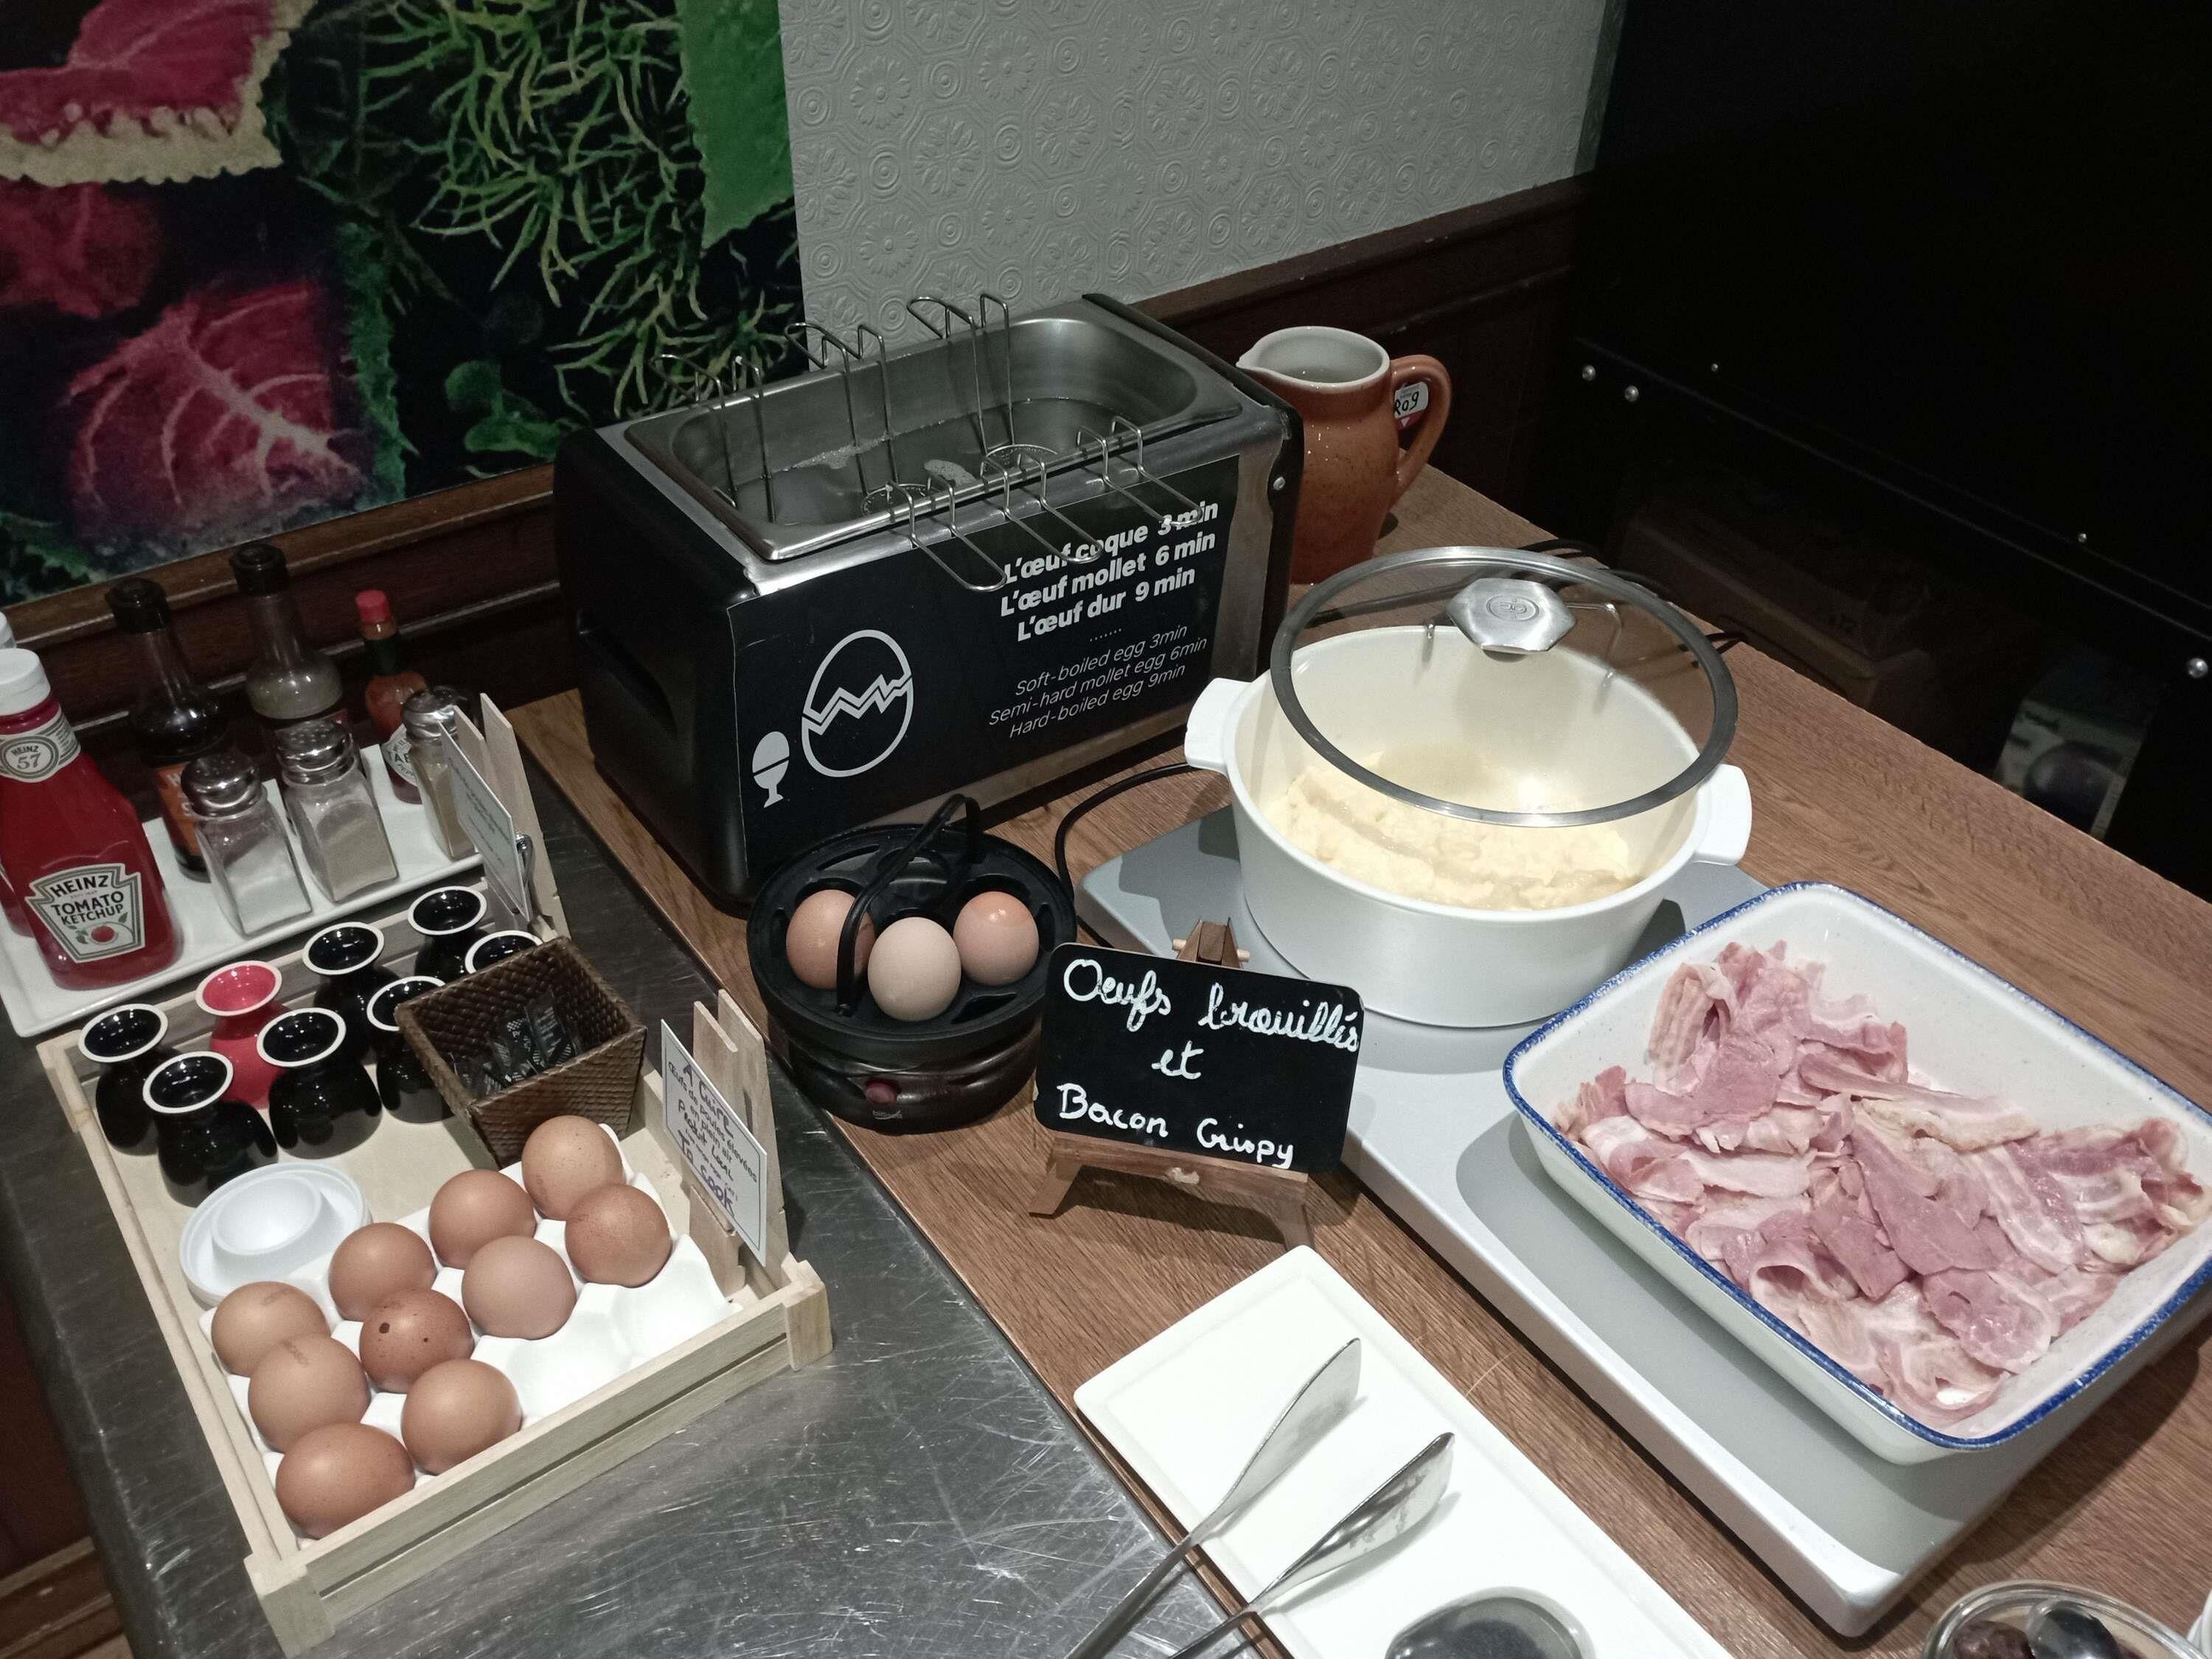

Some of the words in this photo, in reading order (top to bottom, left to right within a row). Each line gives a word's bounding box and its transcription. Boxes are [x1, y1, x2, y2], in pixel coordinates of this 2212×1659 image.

[1004, 543, 1071, 583] L'œuf
[1158, 515, 1172, 535] 3
[1176, 501, 1218, 530] min
[1001, 574, 1068, 616] L'œuf
[1071, 552, 1147, 594] mollet
[1155, 545, 1170, 566] 6
[1174, 532, 1216, 560] min
[1018, 600, 1084, 641] L'œuf
[1087, 591, 1127, 618] dur
[1135, 582, 1150, 602] 9
[1154, 567, 1195, 597] min
[989, 684, 1076, 726] Semi-hard
[1079, 664, 1130, 694] mollet
[1134, 653, 1166, 674] egg
[1170, 637, 1207, 660] 6min
[1015, 649, 1110, 696] Soft-boiled
[1113, 641, 1146, 661] egg
[1150, 625, 1188, 649] 3min
[1009, 692, 1108, 738] Hard-boiled
[1112, 680, 1144, 701] egg
[1148, 664, 1186, 688] 9min
[11, 745, 39, 757] HEINZ
[17, 753, 41, 769] 57
[49, 875, 108, 897] HEINZ
[51, 891, 125, 917] TOMATO
[60, 903, 124, 925] KETCHUP
[1151, 1040, 1204, 1079] et
[700, 1104, 725, 1141] poules
[701, 1119, 720, 1149] plein
[722, 1147, 732, 1164] air
[1057, 1083, 1169, 1138] Bacon
[1197, 1118, 1294, 1169] Crispy
